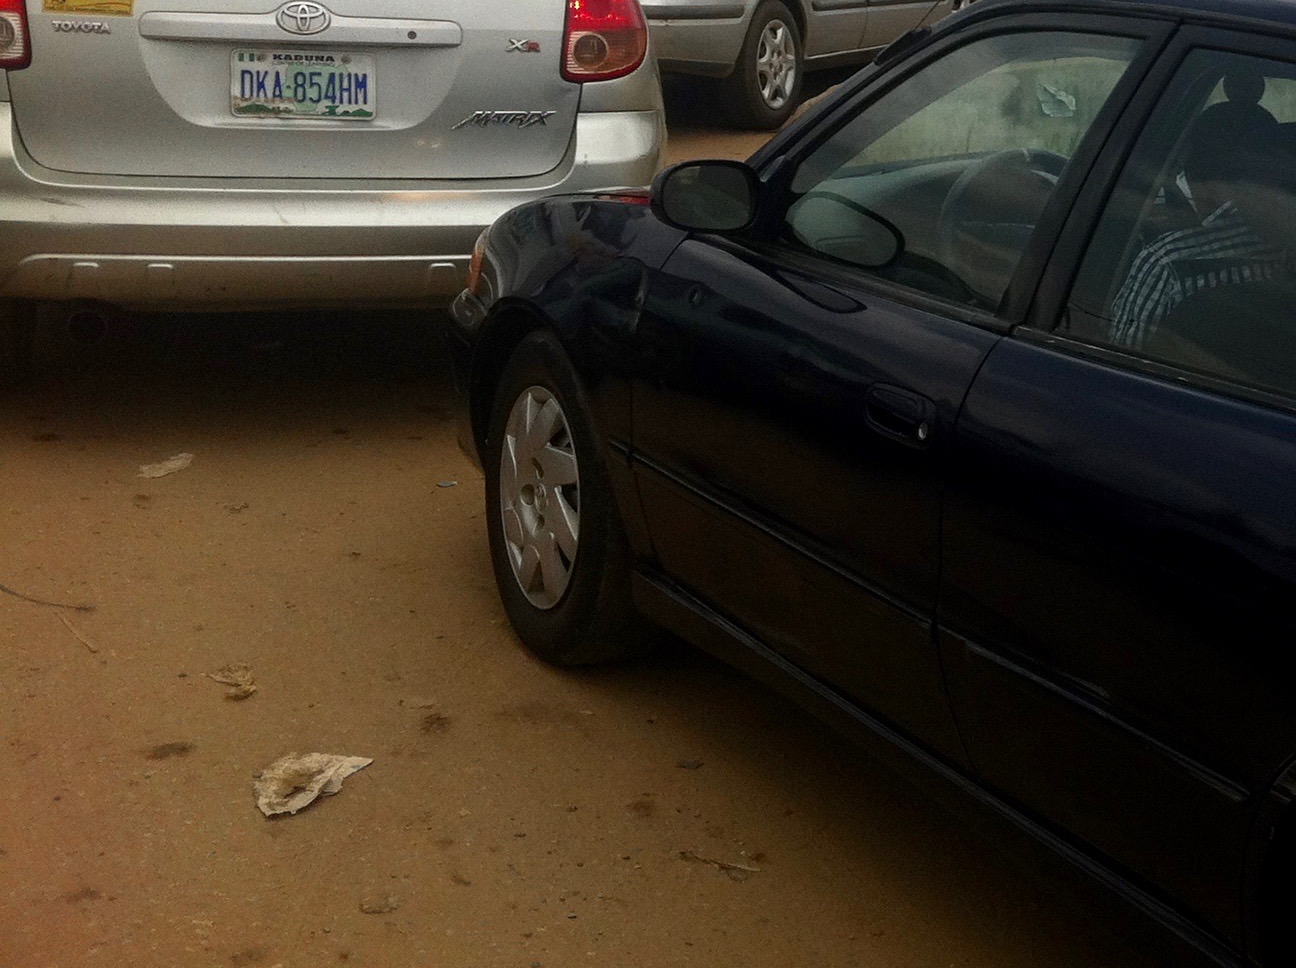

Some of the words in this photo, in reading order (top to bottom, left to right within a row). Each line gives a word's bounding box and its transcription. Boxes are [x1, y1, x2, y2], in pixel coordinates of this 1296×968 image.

[52, 20, 111, 34] TOYOTA
[505, 38, 541, 53] XR
[272, 53, 335, 62] KADUNA
[451, 110, 557, 130] MATRIX
